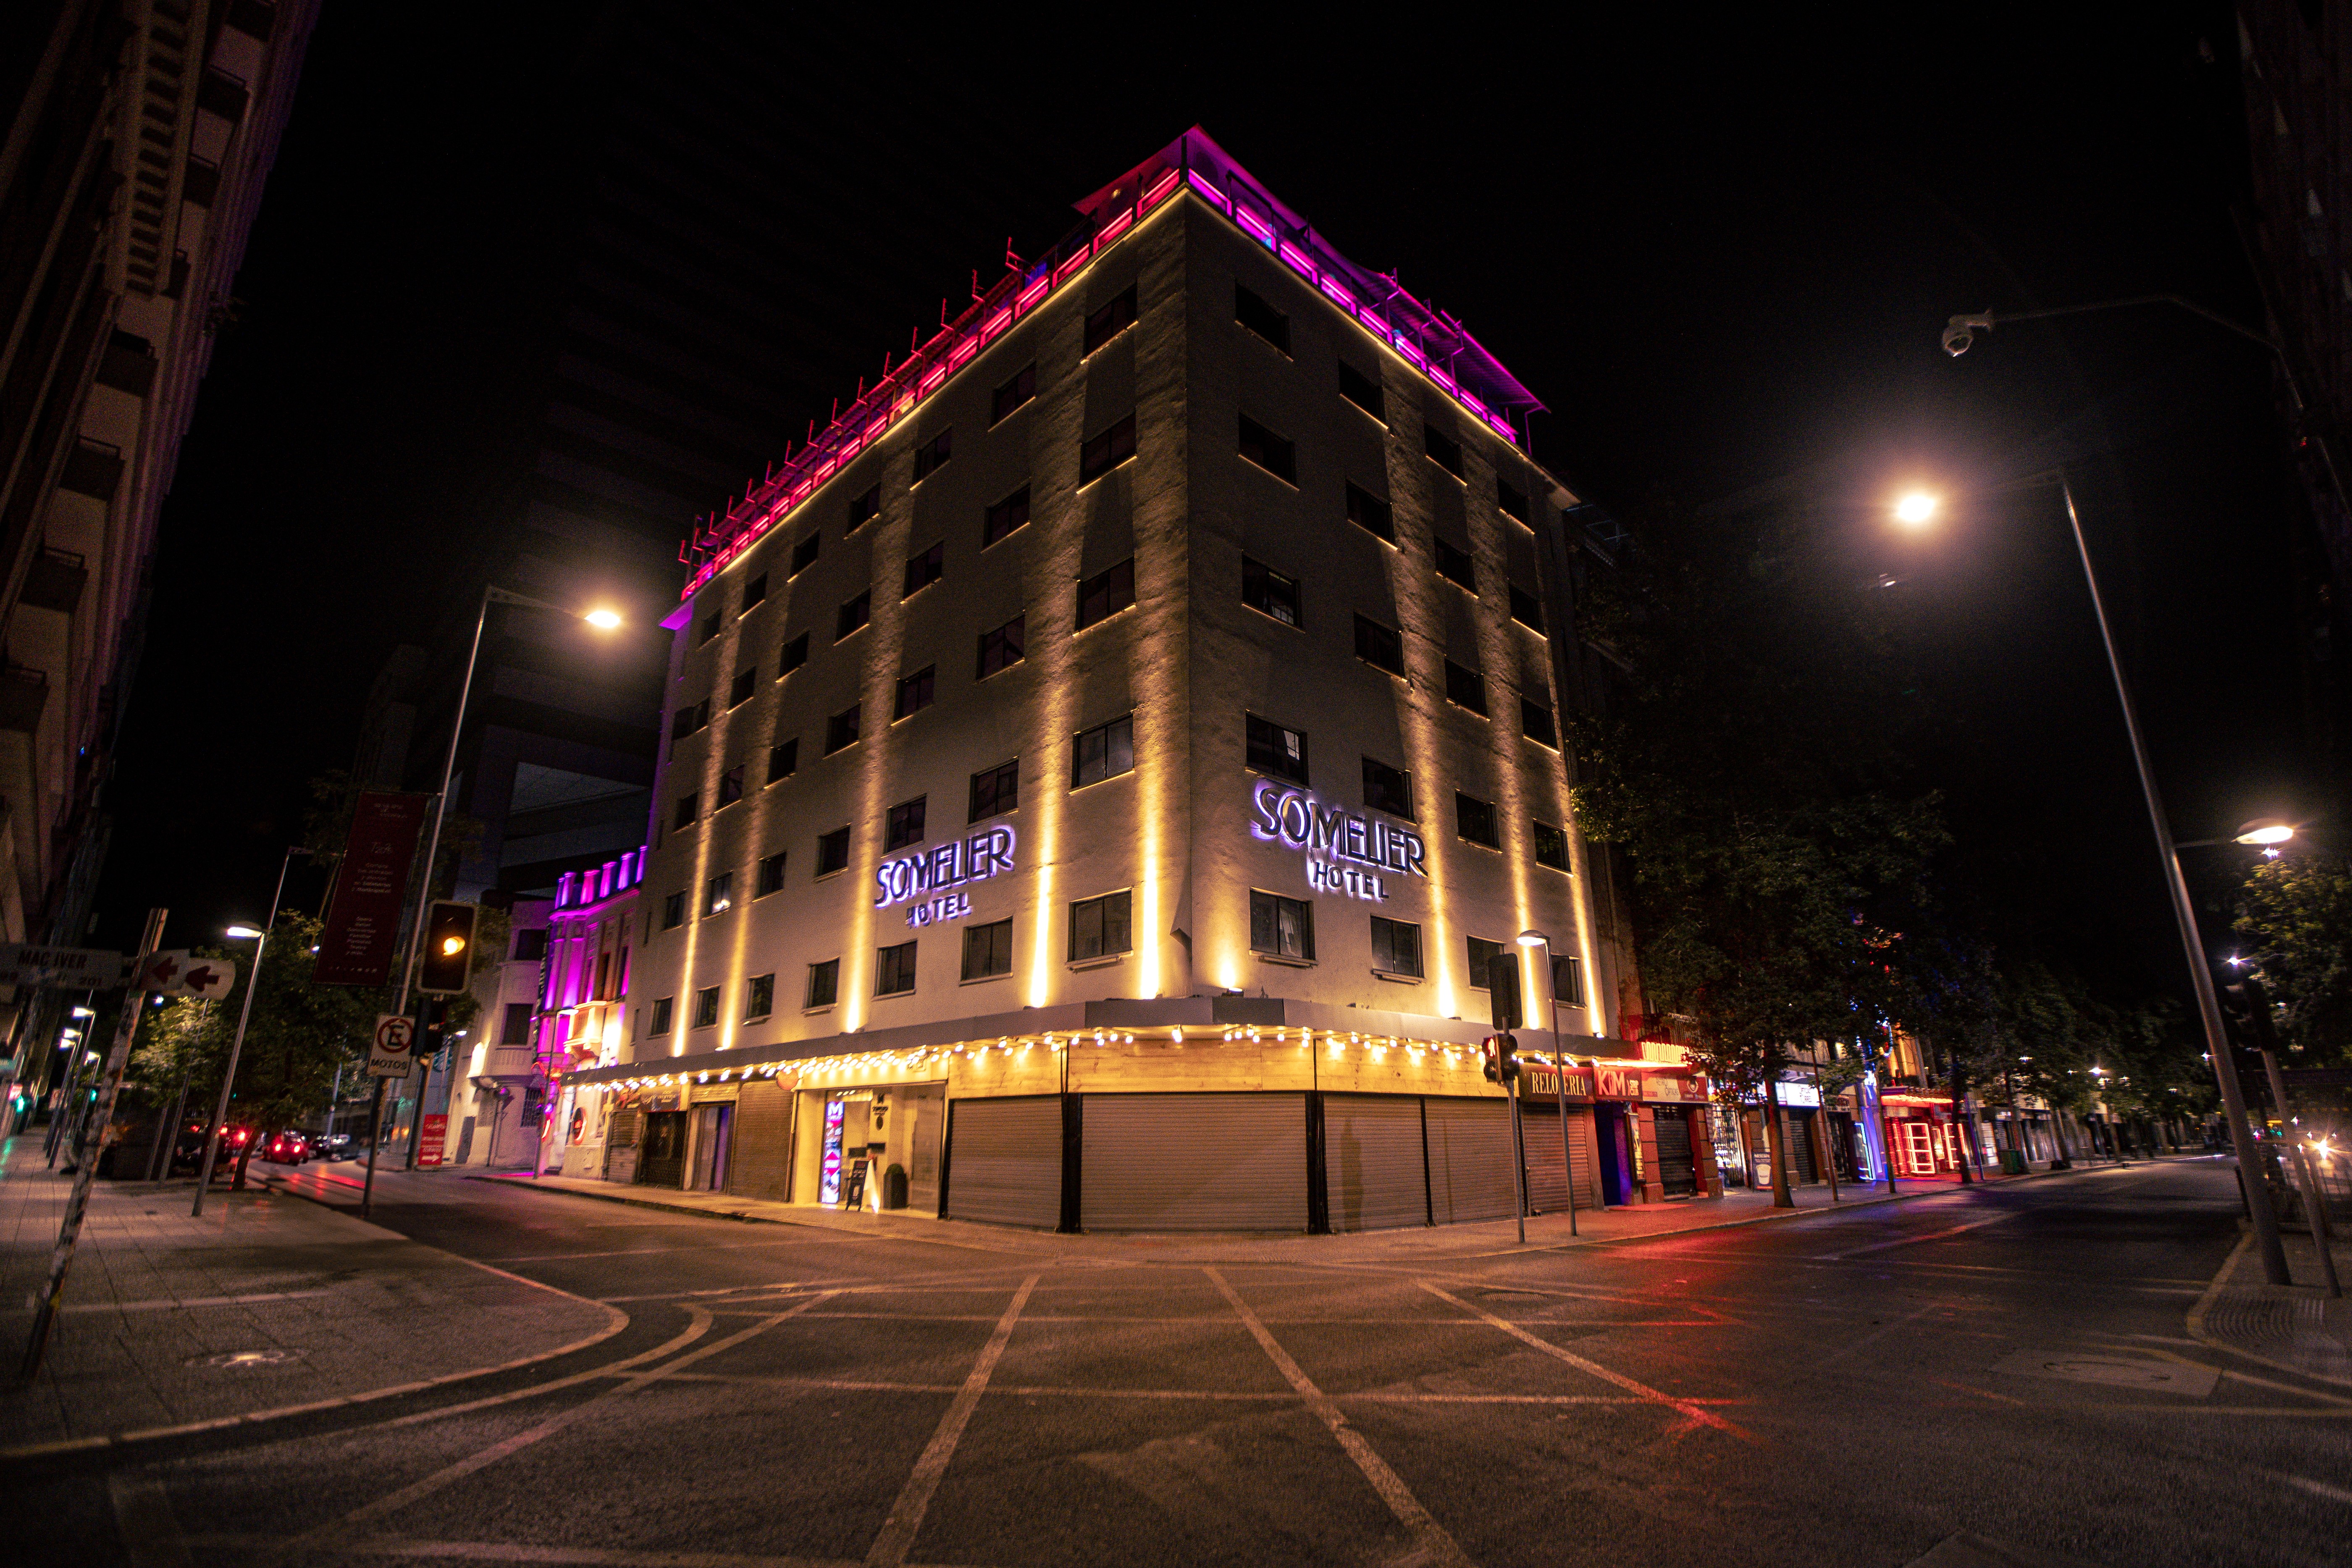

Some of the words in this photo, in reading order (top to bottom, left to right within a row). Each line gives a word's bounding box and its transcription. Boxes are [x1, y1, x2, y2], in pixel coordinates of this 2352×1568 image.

[1258, 788, 1428, 877] SOMELIER
[874, 827, 1015, 906] SOMELIER
[1313, 862, 1389, 899] HOTEL
[906, 893, 971, 927] HOTEL
[17, 950, 50, 966] MAC
[53, 952, 87, 969] IVER
[78, 977, 102, 986] 201
[370, 1058, 407, 1070] MOTOS
[1531, 1072, 1587, 1096] RELOERIA
